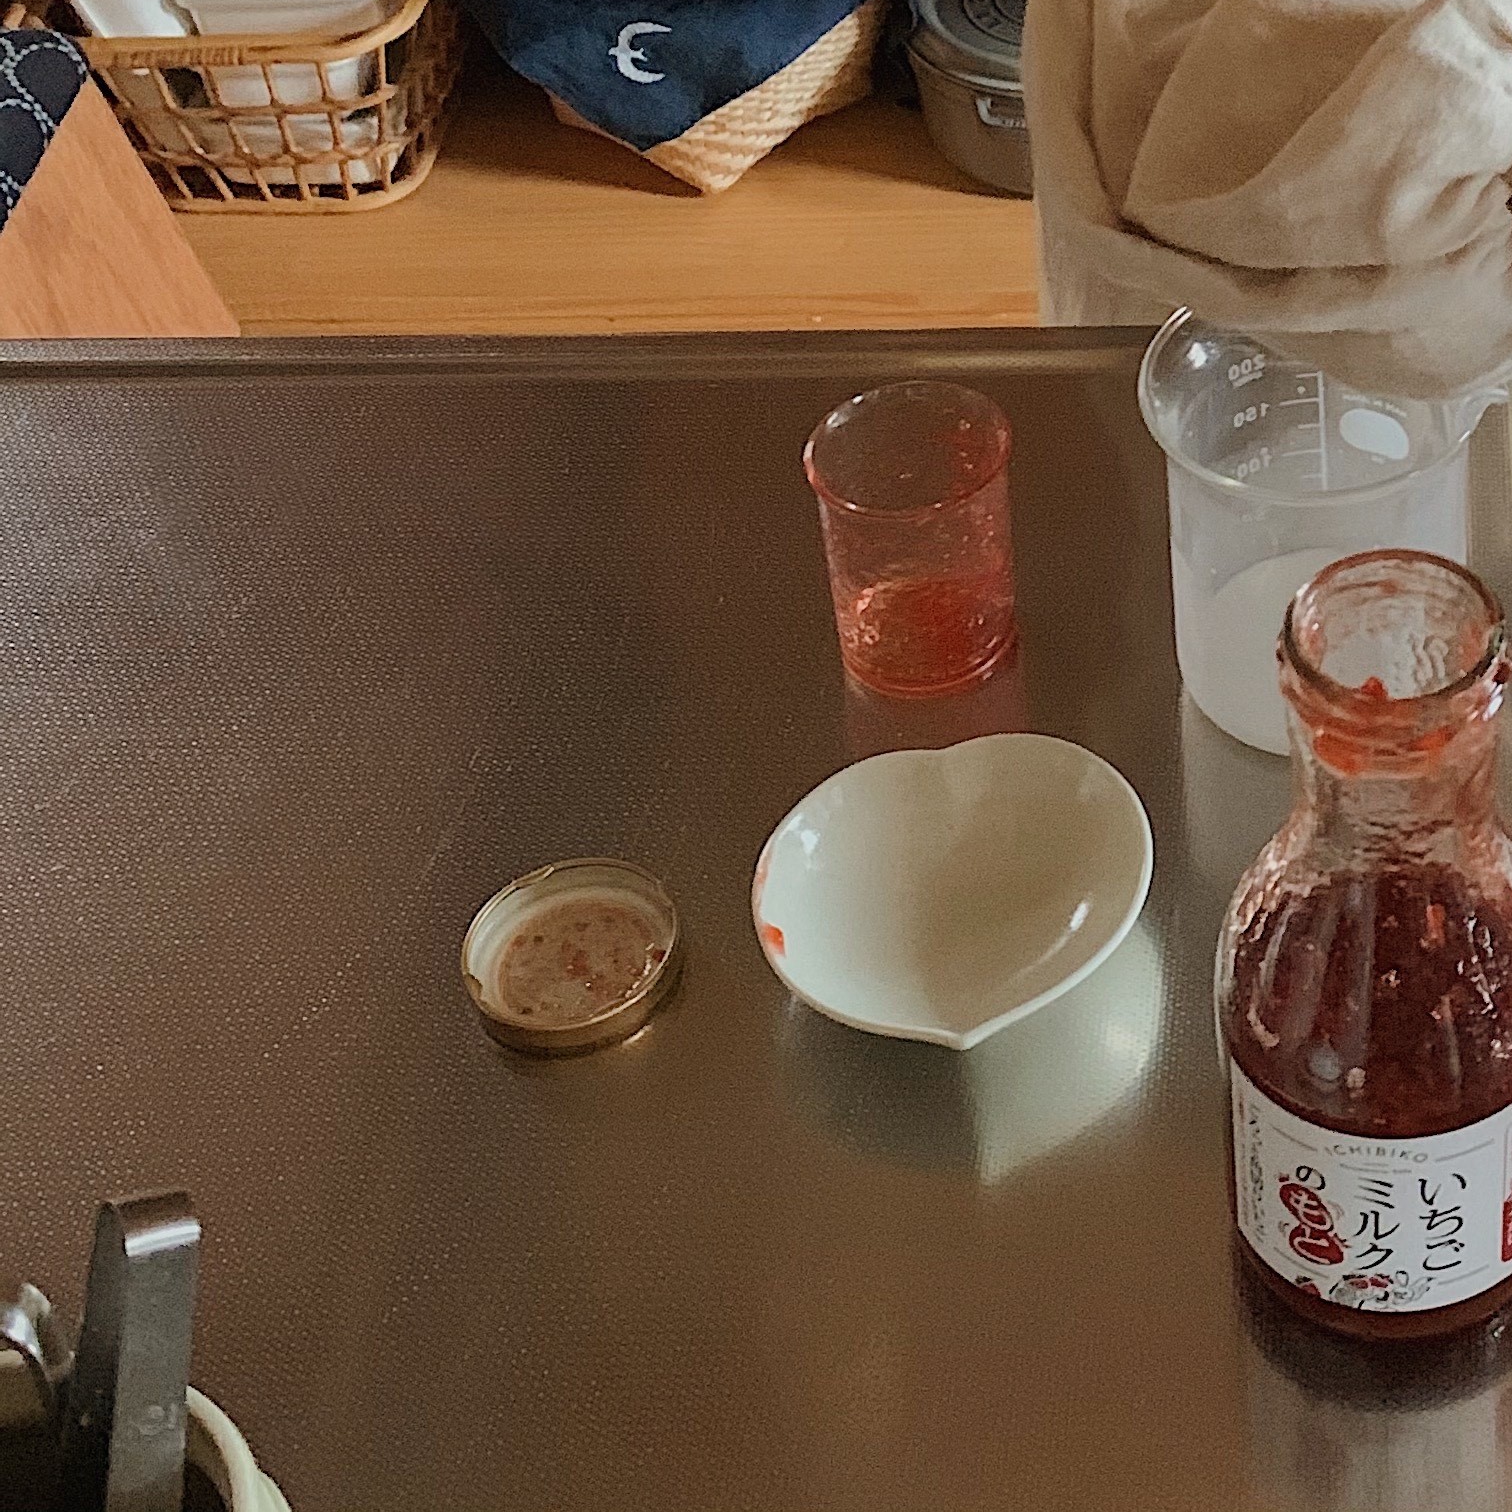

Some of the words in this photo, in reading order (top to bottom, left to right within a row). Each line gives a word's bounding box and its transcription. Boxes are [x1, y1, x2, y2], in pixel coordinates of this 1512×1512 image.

[1288, 1165, 1334, 1266] のもと
[1353, 1177, 1401, 1270] ミルク
[1418, 1173, 1467, 1271] いちご
